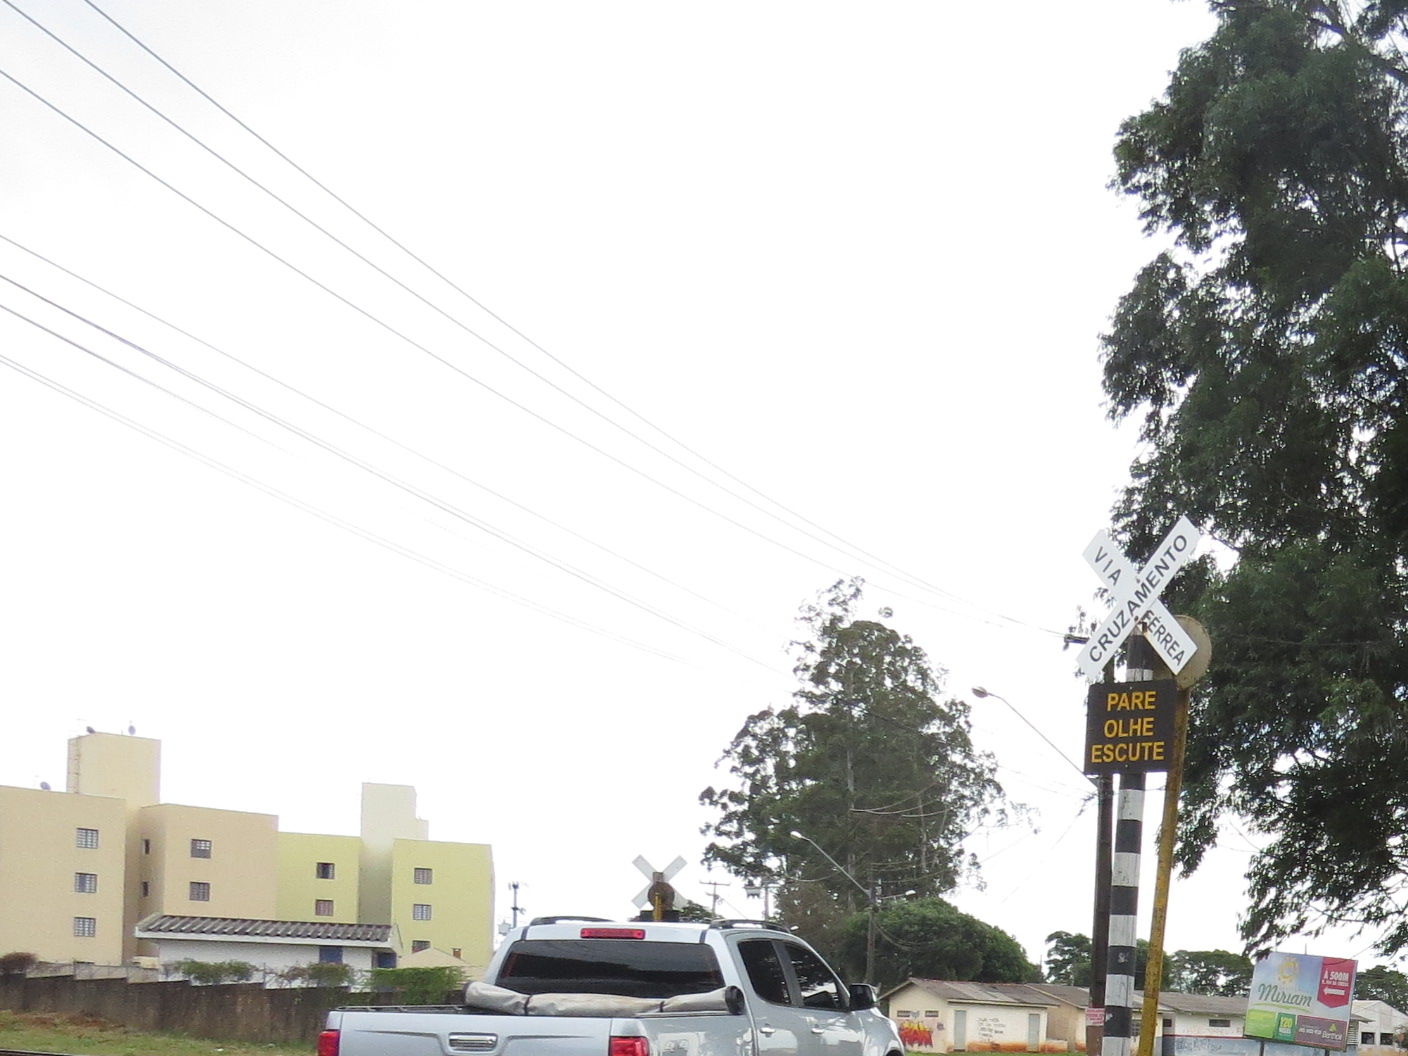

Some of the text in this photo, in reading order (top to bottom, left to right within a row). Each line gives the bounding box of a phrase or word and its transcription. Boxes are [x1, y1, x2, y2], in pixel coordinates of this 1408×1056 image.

[1094, 546, 1122, 587] VIA
[1089, 534, 1187, 663] CRUZAMENTO
[1141, 610, 1186, 667] FÉRREA
[1107, 691, 1156, 711] PARE
[1104, 717, 1154, 738] OLHE
[1091, 742, 1165, 763] ESCUTE
[1258, 983, 1312, 1008] Miriam
